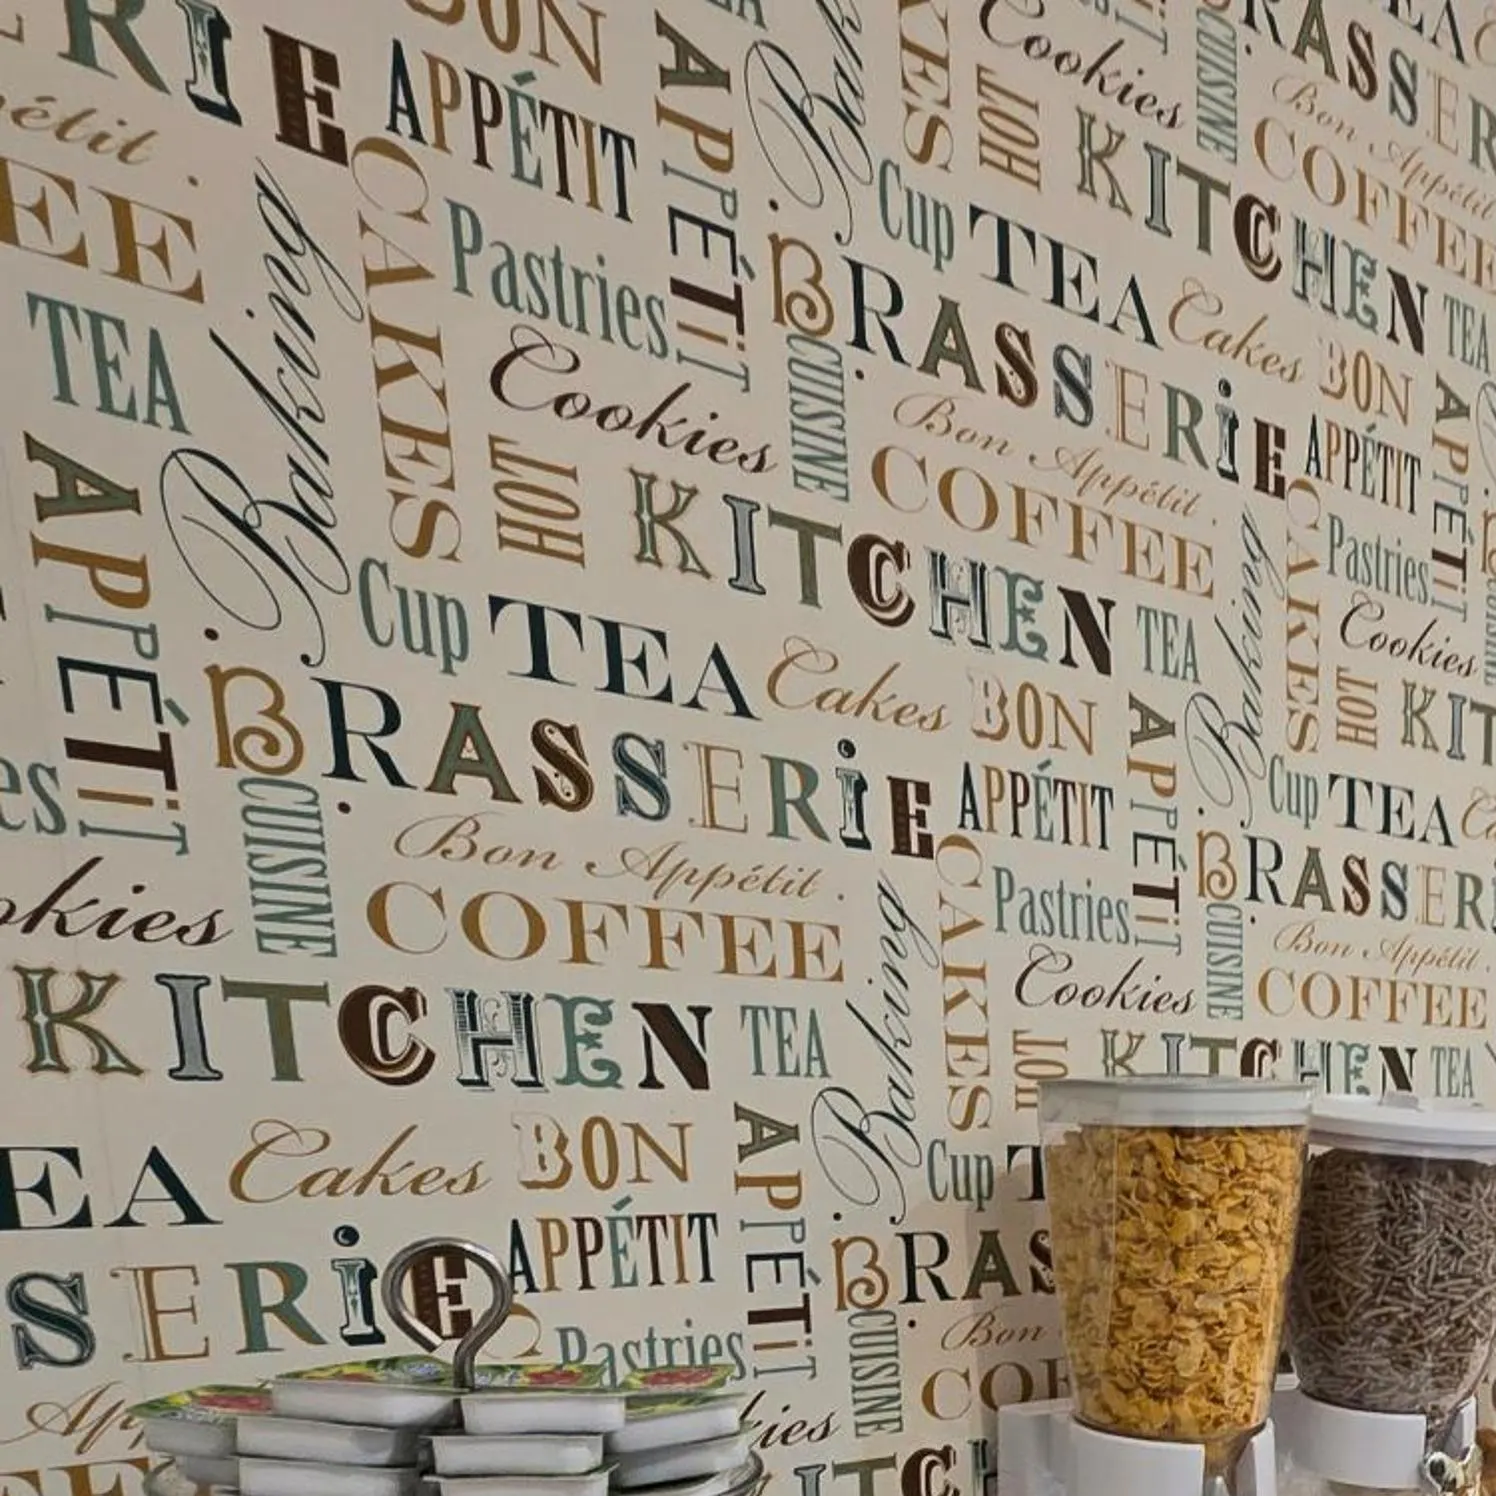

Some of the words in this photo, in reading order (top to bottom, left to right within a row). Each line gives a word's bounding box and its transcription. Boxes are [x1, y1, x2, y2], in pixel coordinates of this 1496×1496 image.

[408, 0, 606, 86] ON
[1196, 8, 1239, 165] CUISINE
[0, 95, 159, 166] étit
[384, 37, 640, 224] APPÉTIT
[975, 62, 1040, 192] HOT
[1272, 75, 1355, 141] Bon
[1369, 141, 1495, 220] Appétit
[879, 157, 954, 273] Cup
[1076, 104, 1430, 356] KITCHEN
[443, 196, 668, 359] Pastries
[970, 201, 1161, 349] TEA
[24, 291, 192, 435] TEA
[349, 136, 462, 564] CAKES
[1169, 277, 1301, 382] Cakes
[1318, 331, 1413, 426] BON
[1442, 292, 1490, 375] TEA
[158, 156, 364, 668] Baking
[488, 323, 774, 473] Cookies
[787, 333, 850, 502] CUISINE
[487, 433, 585, 568] HOT
[893, 393, 1007, 455] Bon
[1030, 447, 1200, 517] Appétit
[1304, 413, 1421, 516] APPÉTIT
[626, 464, 1116, 677] KITCHEN
[874, 445, 1212, 599] COFFEE
[1327, 512, 1426, 604] Pastries
[359, 556, 469, 676] Cup
[487, 593, 761, 721] TEA
[1136, 603, 1201, 685] TEA
[1185, 502, 1284, 828] Baking
[1285, 479, 1320, 753] CAKES
[1340, 590, 1474, 676] Cookies
[766, 635, 949, 731] Cakes
[968, 670, 1097, 755] BON
[1336, 664, 1376, 750] HOT
[957, 758, 1114, 851] APPÉTIT
[1269, 753, 1317, 828] Cup
[1330, 772, 1456, 848] TEA
[0, 857, 232, 946] kies
[235, 777, 338, 959] CUISINE
[393, 813, 556, 870] Bon
[584, 841, 821, 902] Appétit
[993, 865, 1129, 945] Pastries
[365, 881, 843, 982] COFFEE
[935, 834, 992, 1131] CAKES
[1015, 944, 1193, 1014] Cookies
[1205, 901, 1243, 1019] CUISINE
[1273, 920, 1349, 956] Bon
[1362, 933, 1479, 975] Appétit
[13, 963, 714, 1093] KITCHEN
[739, 1004, 832, 1079] TEA
[810, 868, 938, 1225] Baking
[1257, 967, 1485, 1028] COFFEE
[1430, 1045, 1474, 1097] TEA
[0, 1146, 222, 1230] EA
[227, 1119, 490, 1202] Cakes
[511, 1115, 692, 1190] BON
[927, 1138, 993, 1211] Cup
[503, 1195, 720, 1295] APPÉTIT
[849, 1308, 903, 1438] CUISINE
[942, 1310, 1043, 1352] Bon
